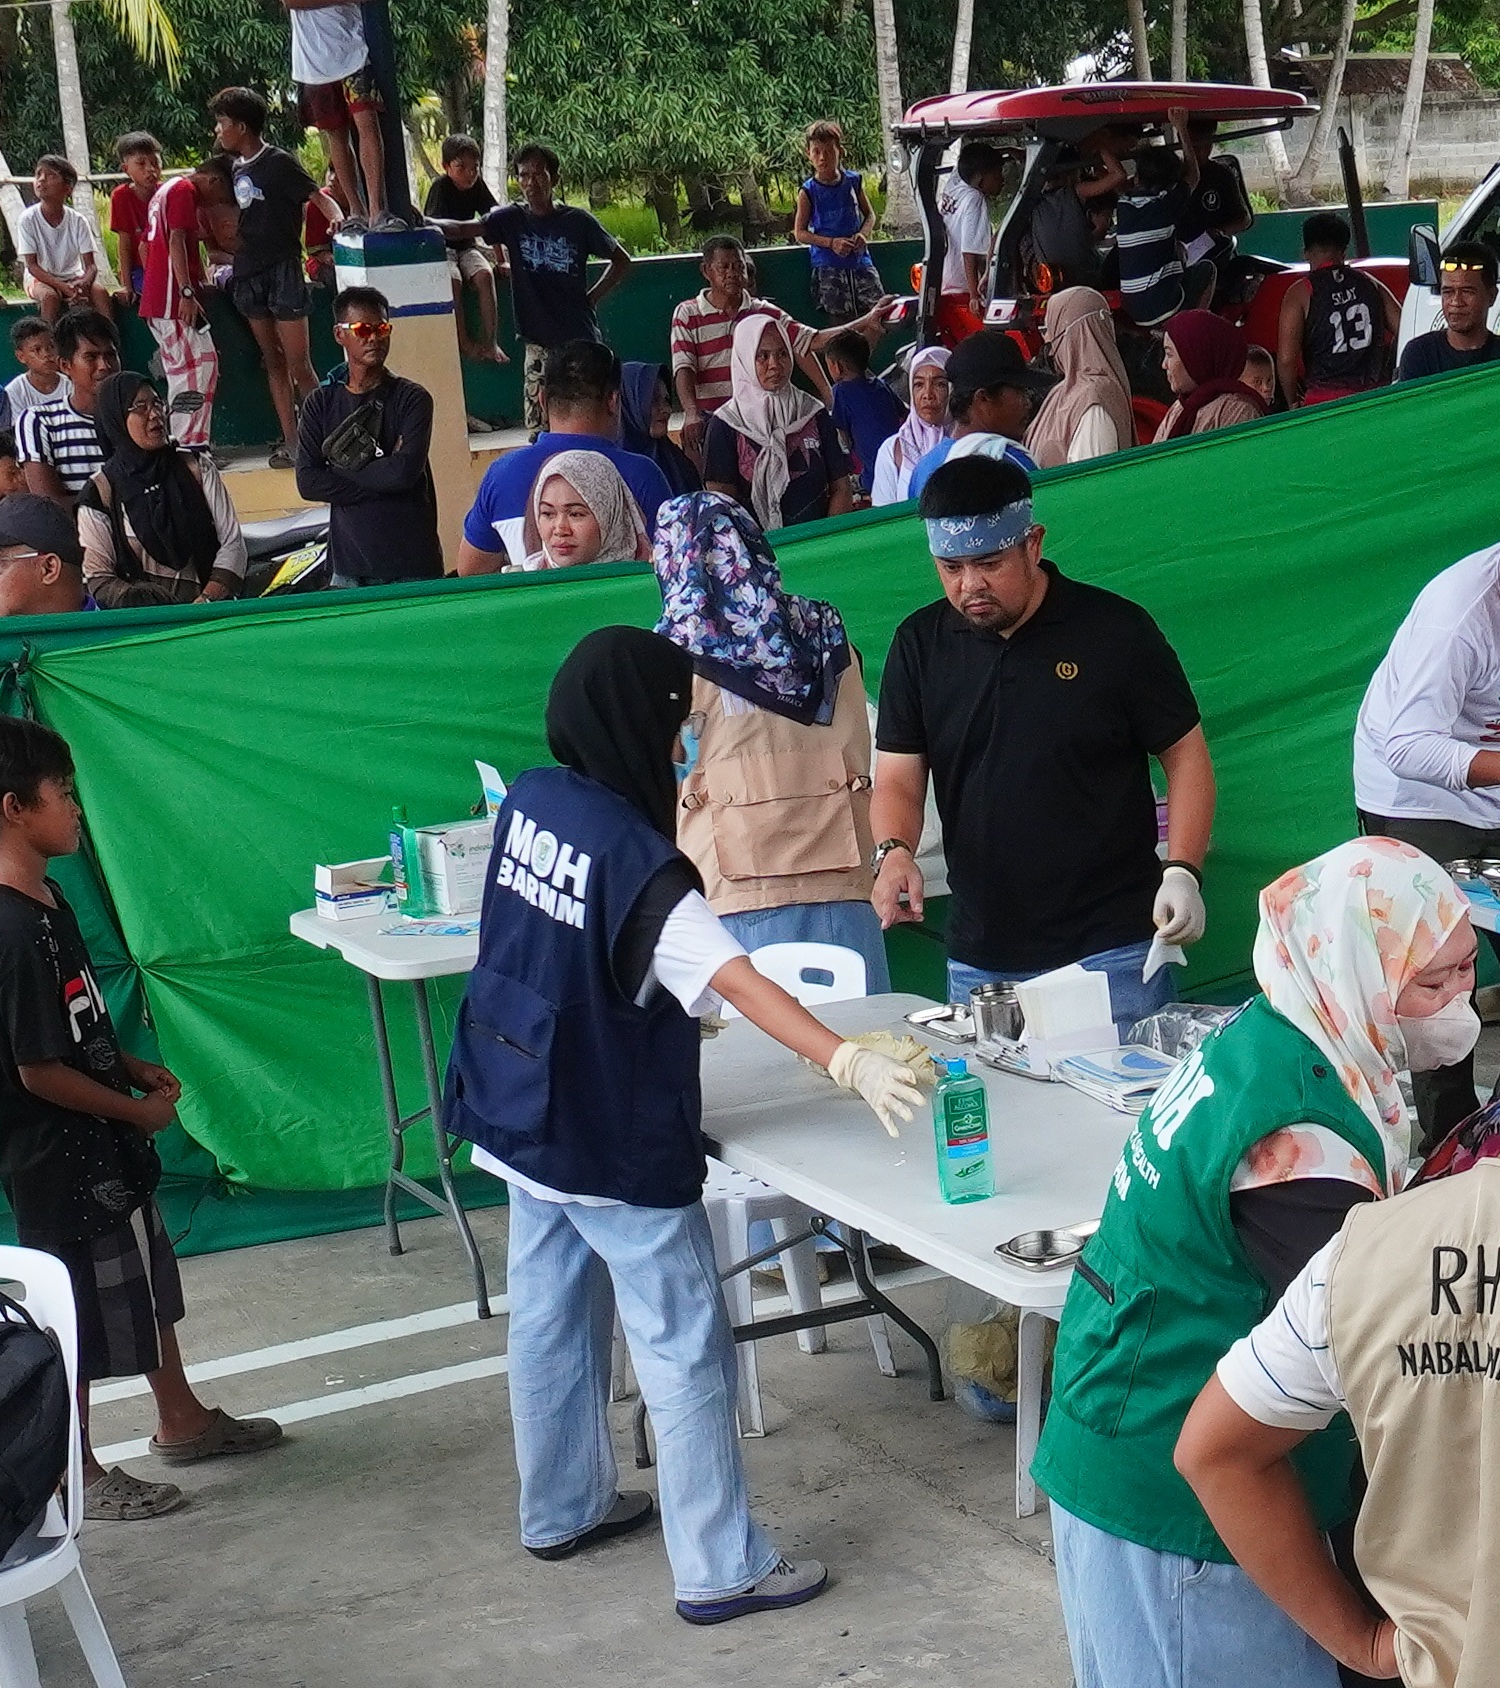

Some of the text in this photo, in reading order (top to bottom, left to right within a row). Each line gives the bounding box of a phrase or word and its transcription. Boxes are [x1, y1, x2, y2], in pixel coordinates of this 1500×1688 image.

[1329, 302, 1373, 354] 13
[503, 808, 592, 901] MOH
[496, 855, 587, 931] BARMM
